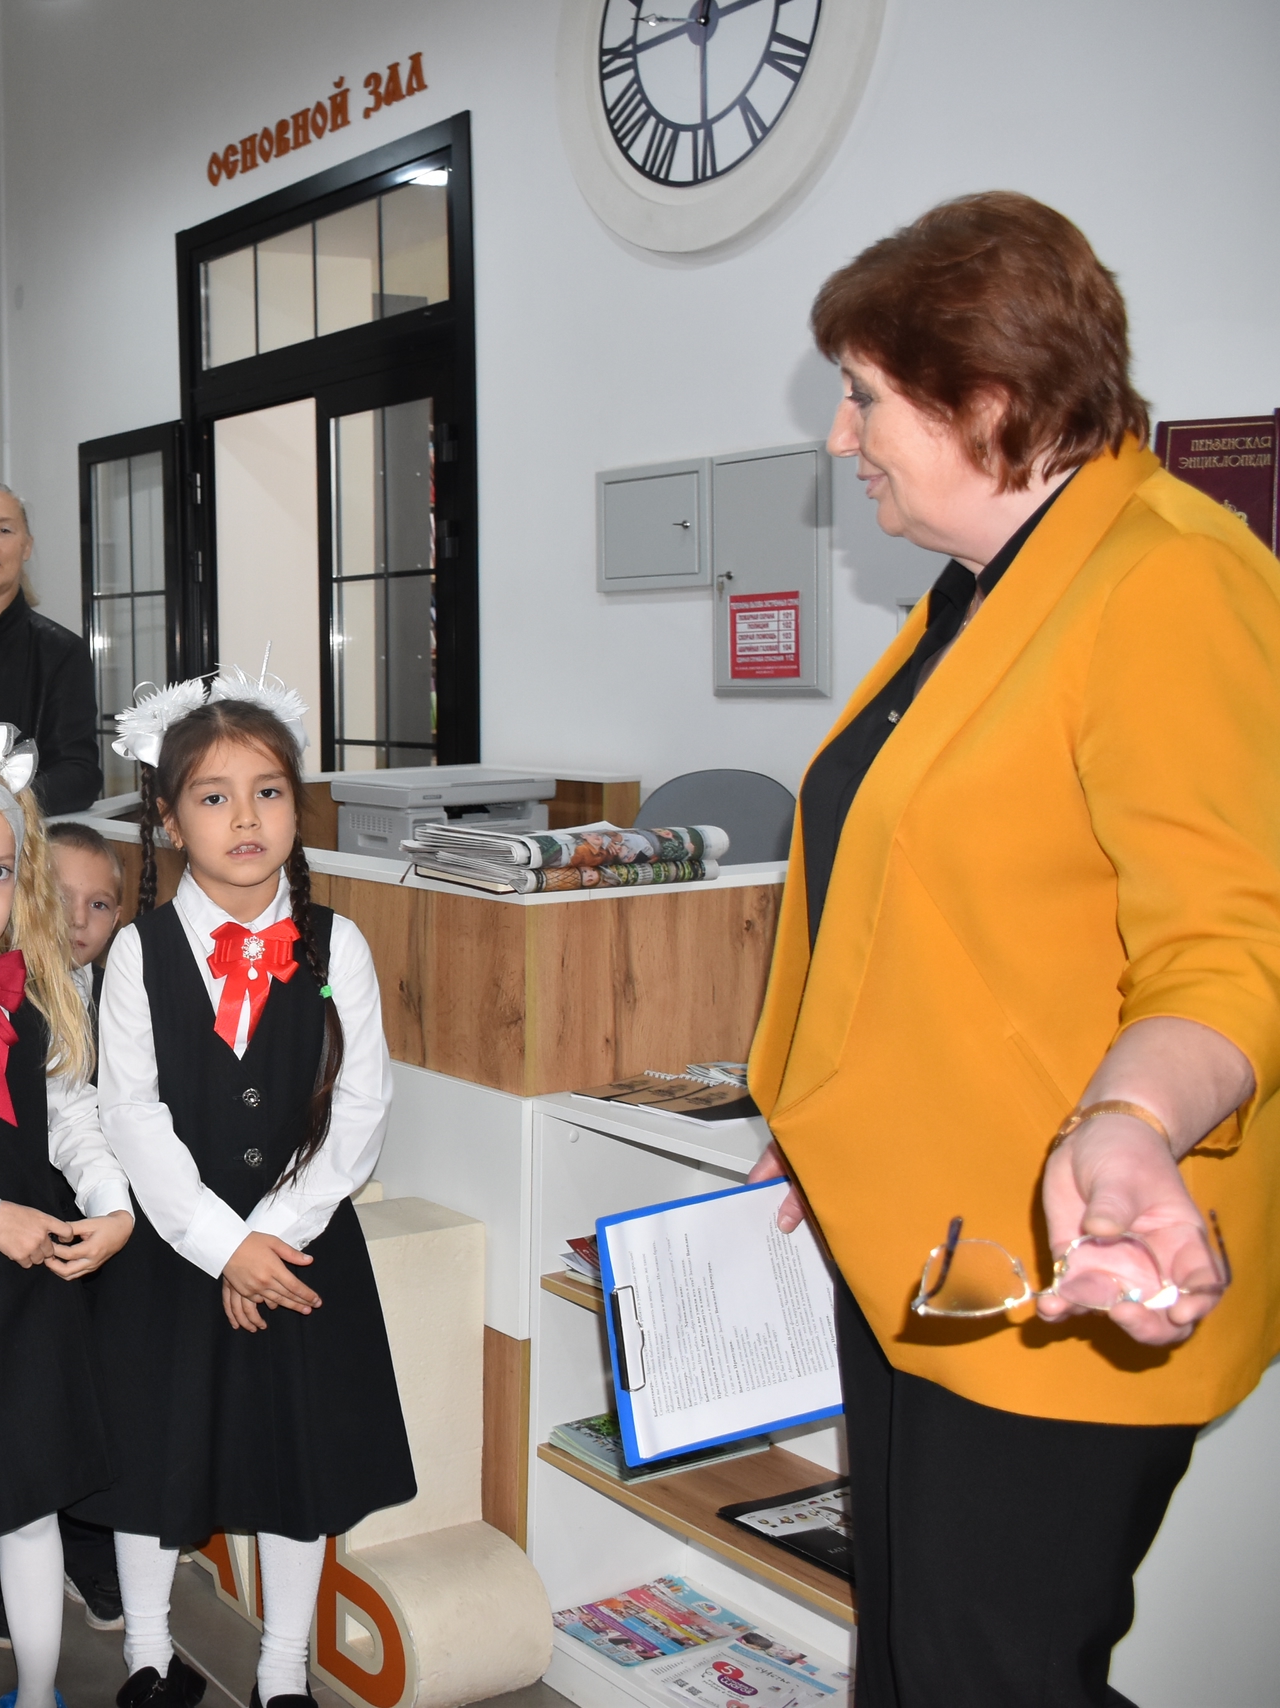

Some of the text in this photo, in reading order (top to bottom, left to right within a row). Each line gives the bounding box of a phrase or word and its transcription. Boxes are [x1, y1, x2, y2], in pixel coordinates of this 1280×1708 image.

[207, 52, 428, 187] ОСНОВНОЙ ЗАЛ
[1191, 437, 1271, 451] ПЕНЗЕНСКАЯ
[720, 1665, 736, 1675] 5
